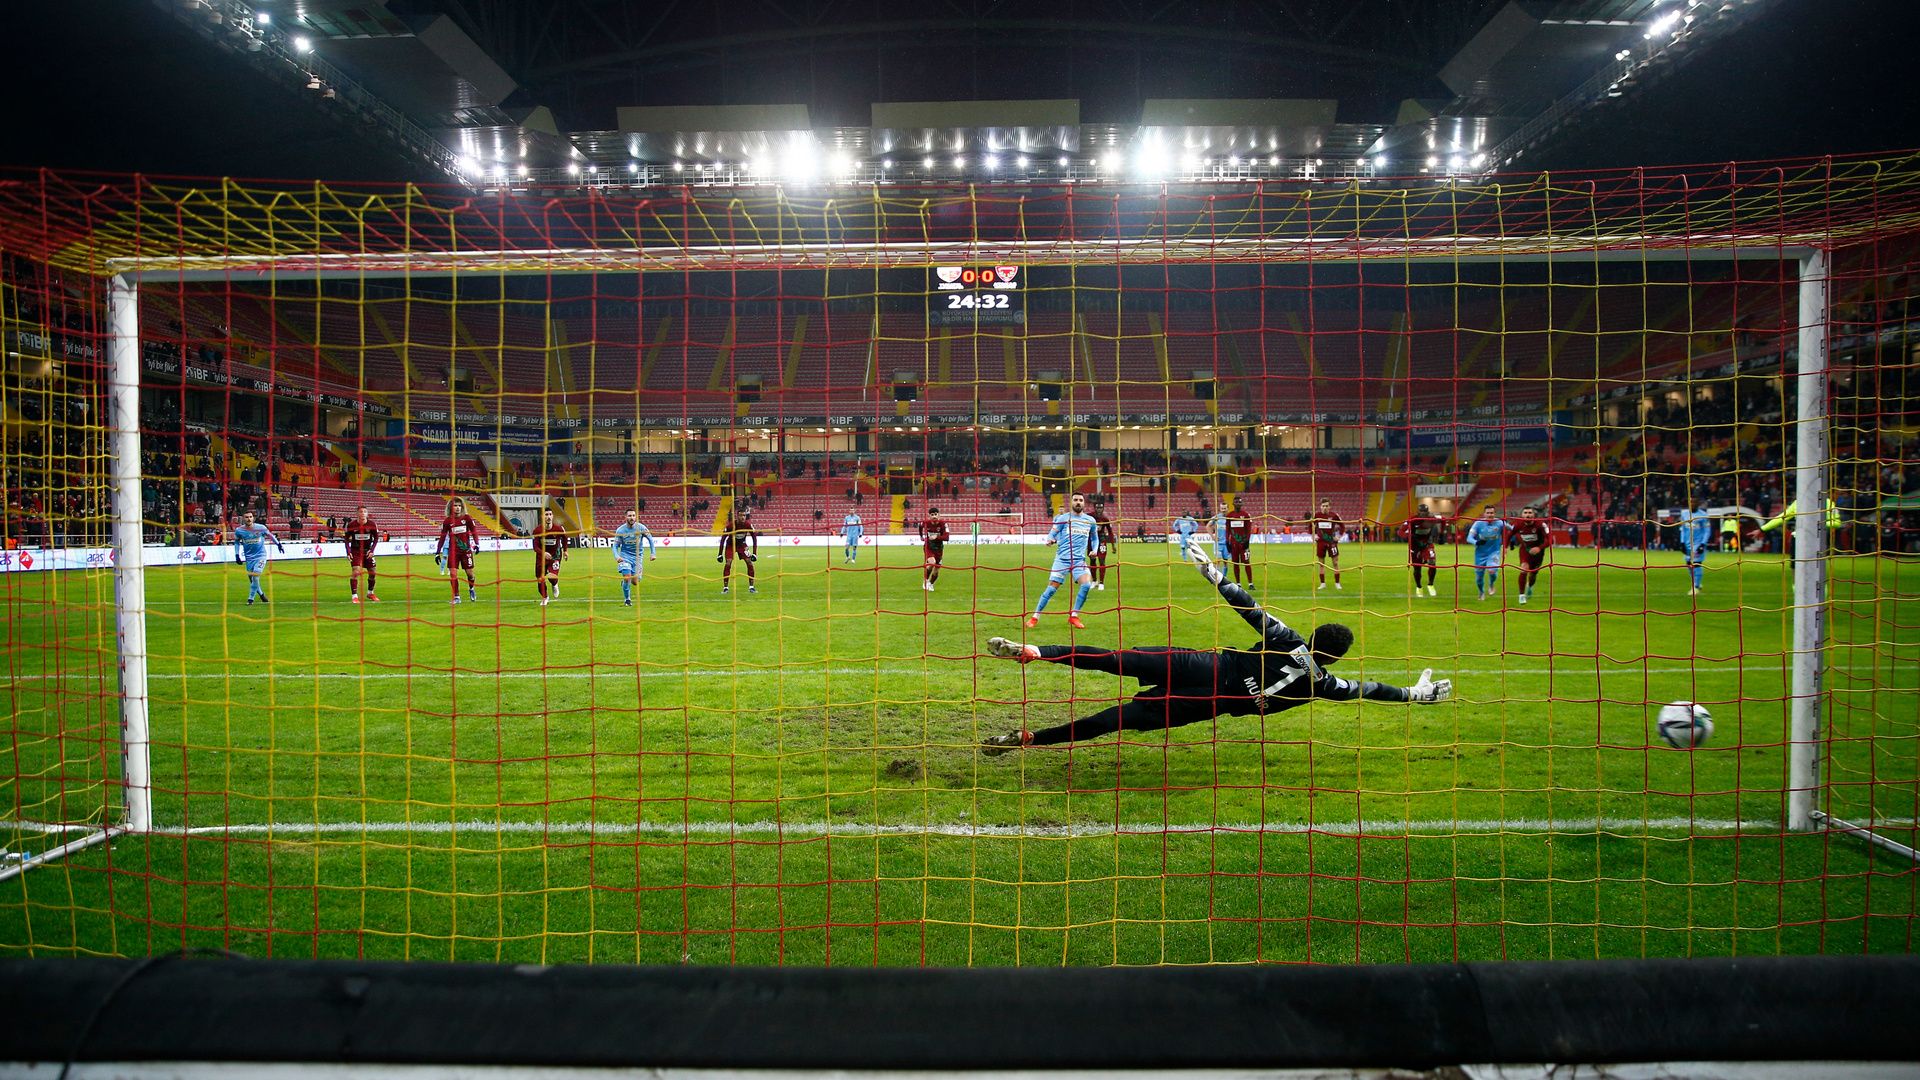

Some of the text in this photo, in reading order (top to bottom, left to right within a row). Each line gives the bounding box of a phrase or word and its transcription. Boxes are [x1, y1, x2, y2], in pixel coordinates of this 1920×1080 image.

[948, 294, 1010, 309] 24:32
[430, 412, 447, 421] iBF
[502, 415, 517, 424] iBF
[752, 416, 769, 425] iBF
[836, 416, 853, 425] iBF
[990, 415, 1007, 424] iBF
[1073, 414, 1090, 423] iBF
[1150, 414, 1166, 423] iBF
[1226, 414, 1243, 422] iBF
[566, 418, 581, 427] iBF
[601, 418, 618, 427] iBF
[422, 425, 449, 444] SİGARA
[1460, 433, 1476, 443] HAS
[497, 496, 518, 504] EDAT
[87, 553, 104, 563] aras
